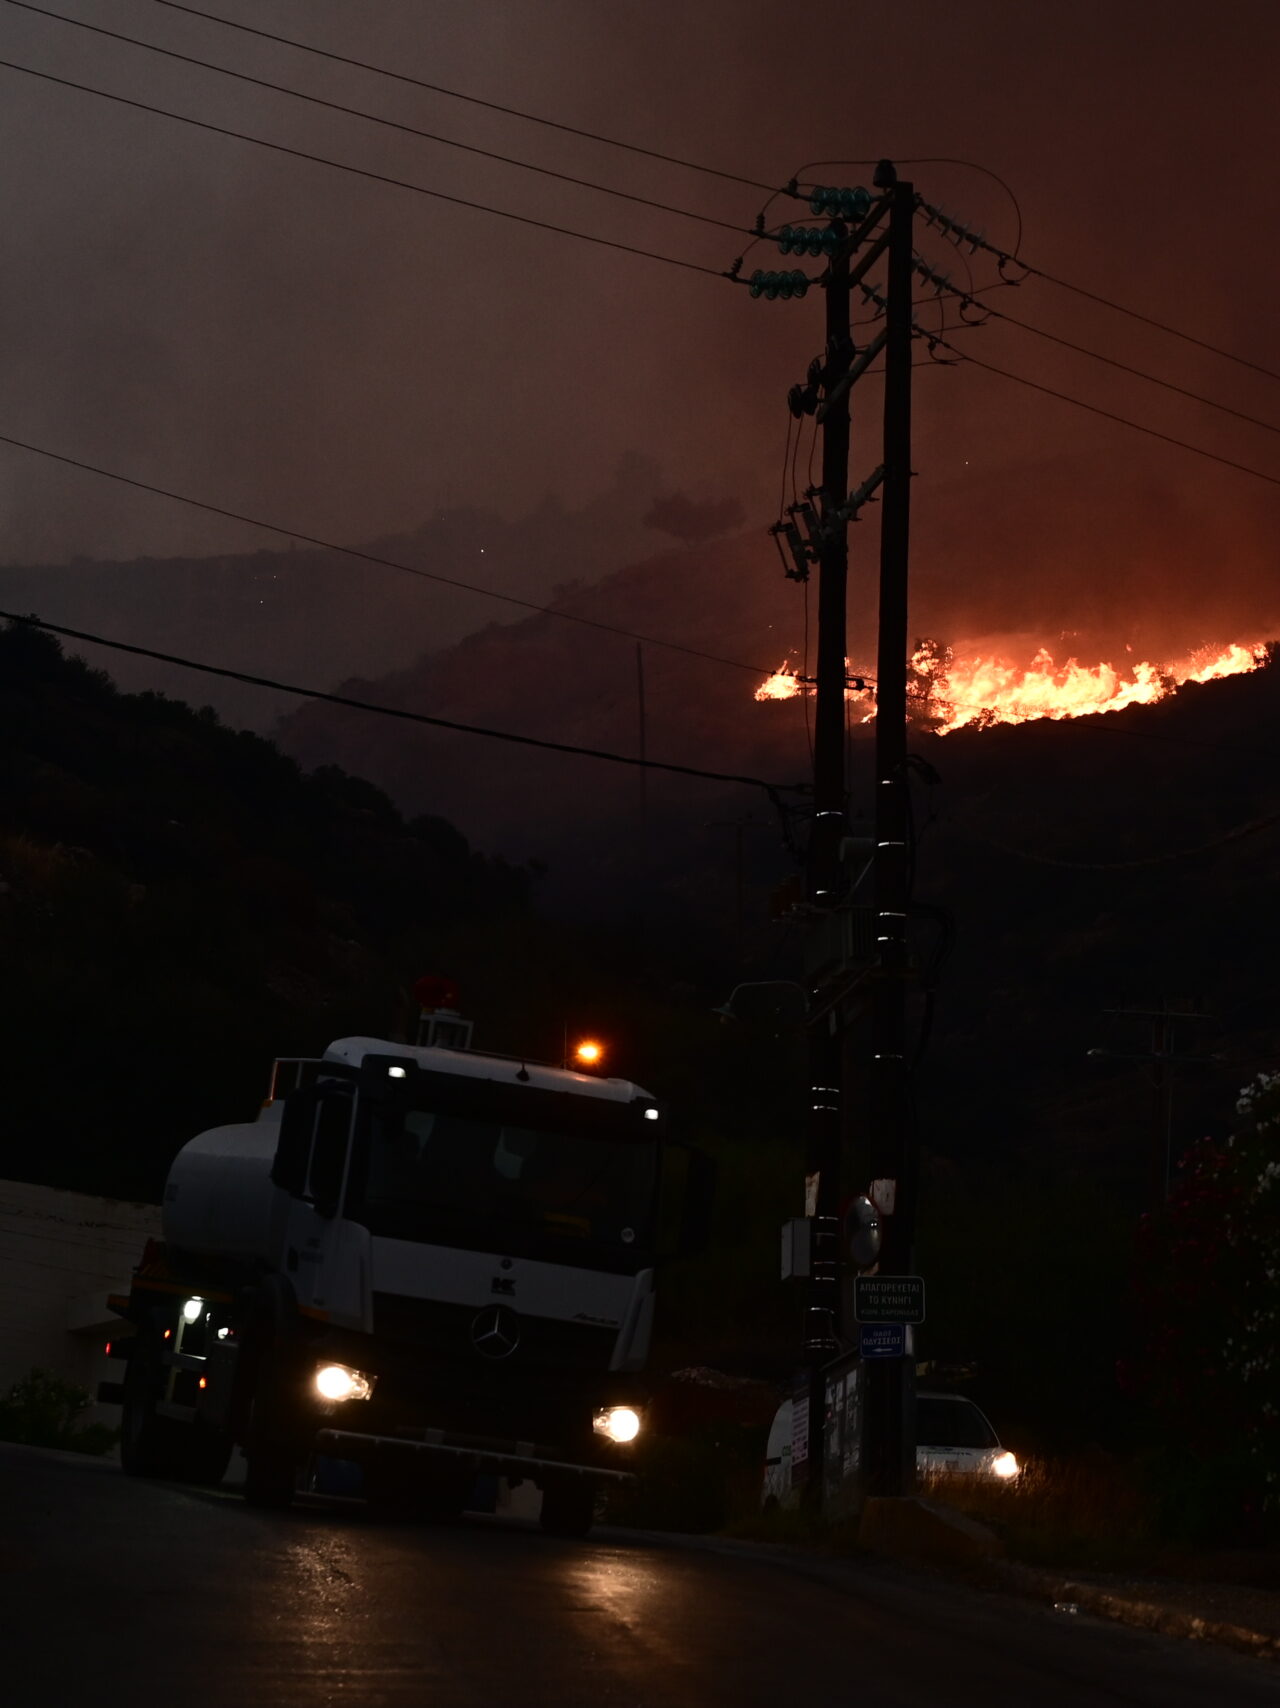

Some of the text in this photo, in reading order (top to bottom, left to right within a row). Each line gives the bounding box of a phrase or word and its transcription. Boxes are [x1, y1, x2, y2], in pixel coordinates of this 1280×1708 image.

[859, 1282, 920, 1293] ΑΠΑΓΟΡΕΥΕΤΑΙ
[869, 1295, 911, 1305] ΤΟ ΚΥΝΗΓΙ
